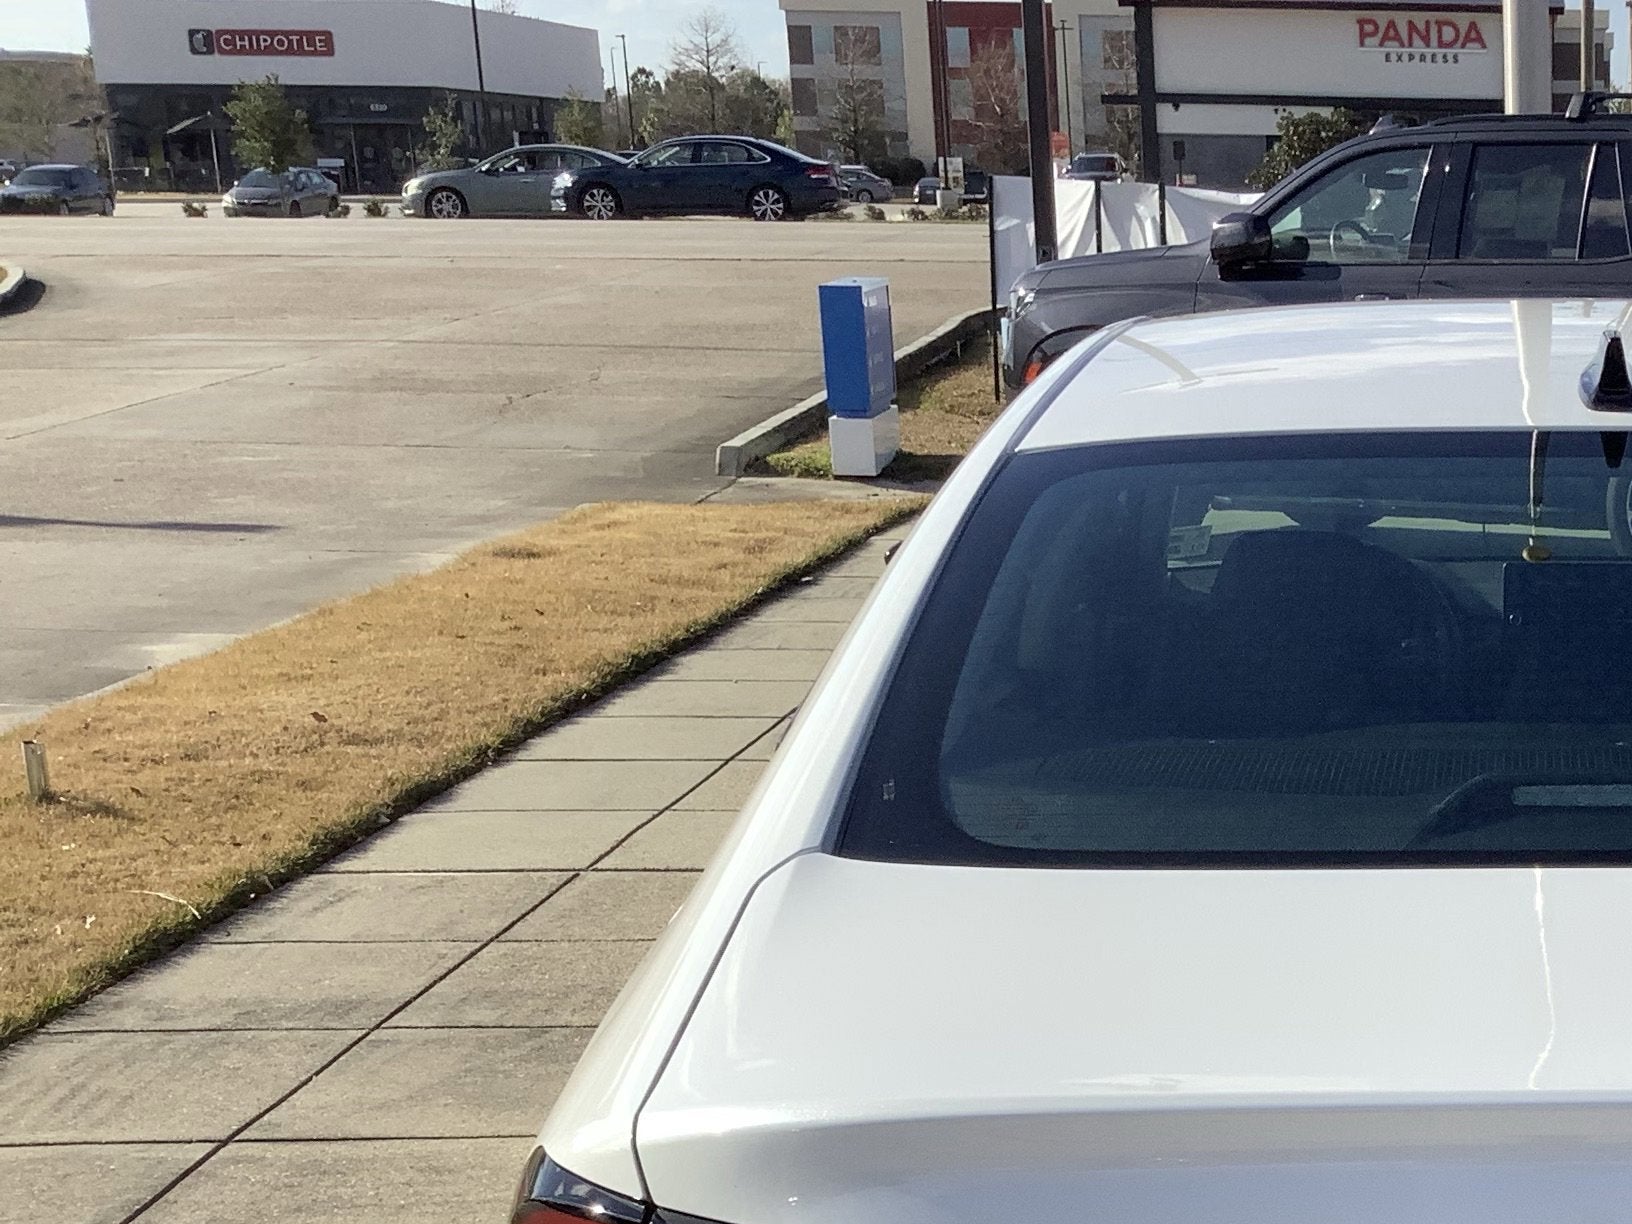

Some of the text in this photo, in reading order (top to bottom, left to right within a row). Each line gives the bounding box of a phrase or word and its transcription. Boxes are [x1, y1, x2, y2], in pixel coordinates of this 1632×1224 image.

[1356, 18, 1487, 49] PANDA
[219, 34, 327, 51] CHIPOTLE
[1384, 52, 1459, 64] EXPRESS
